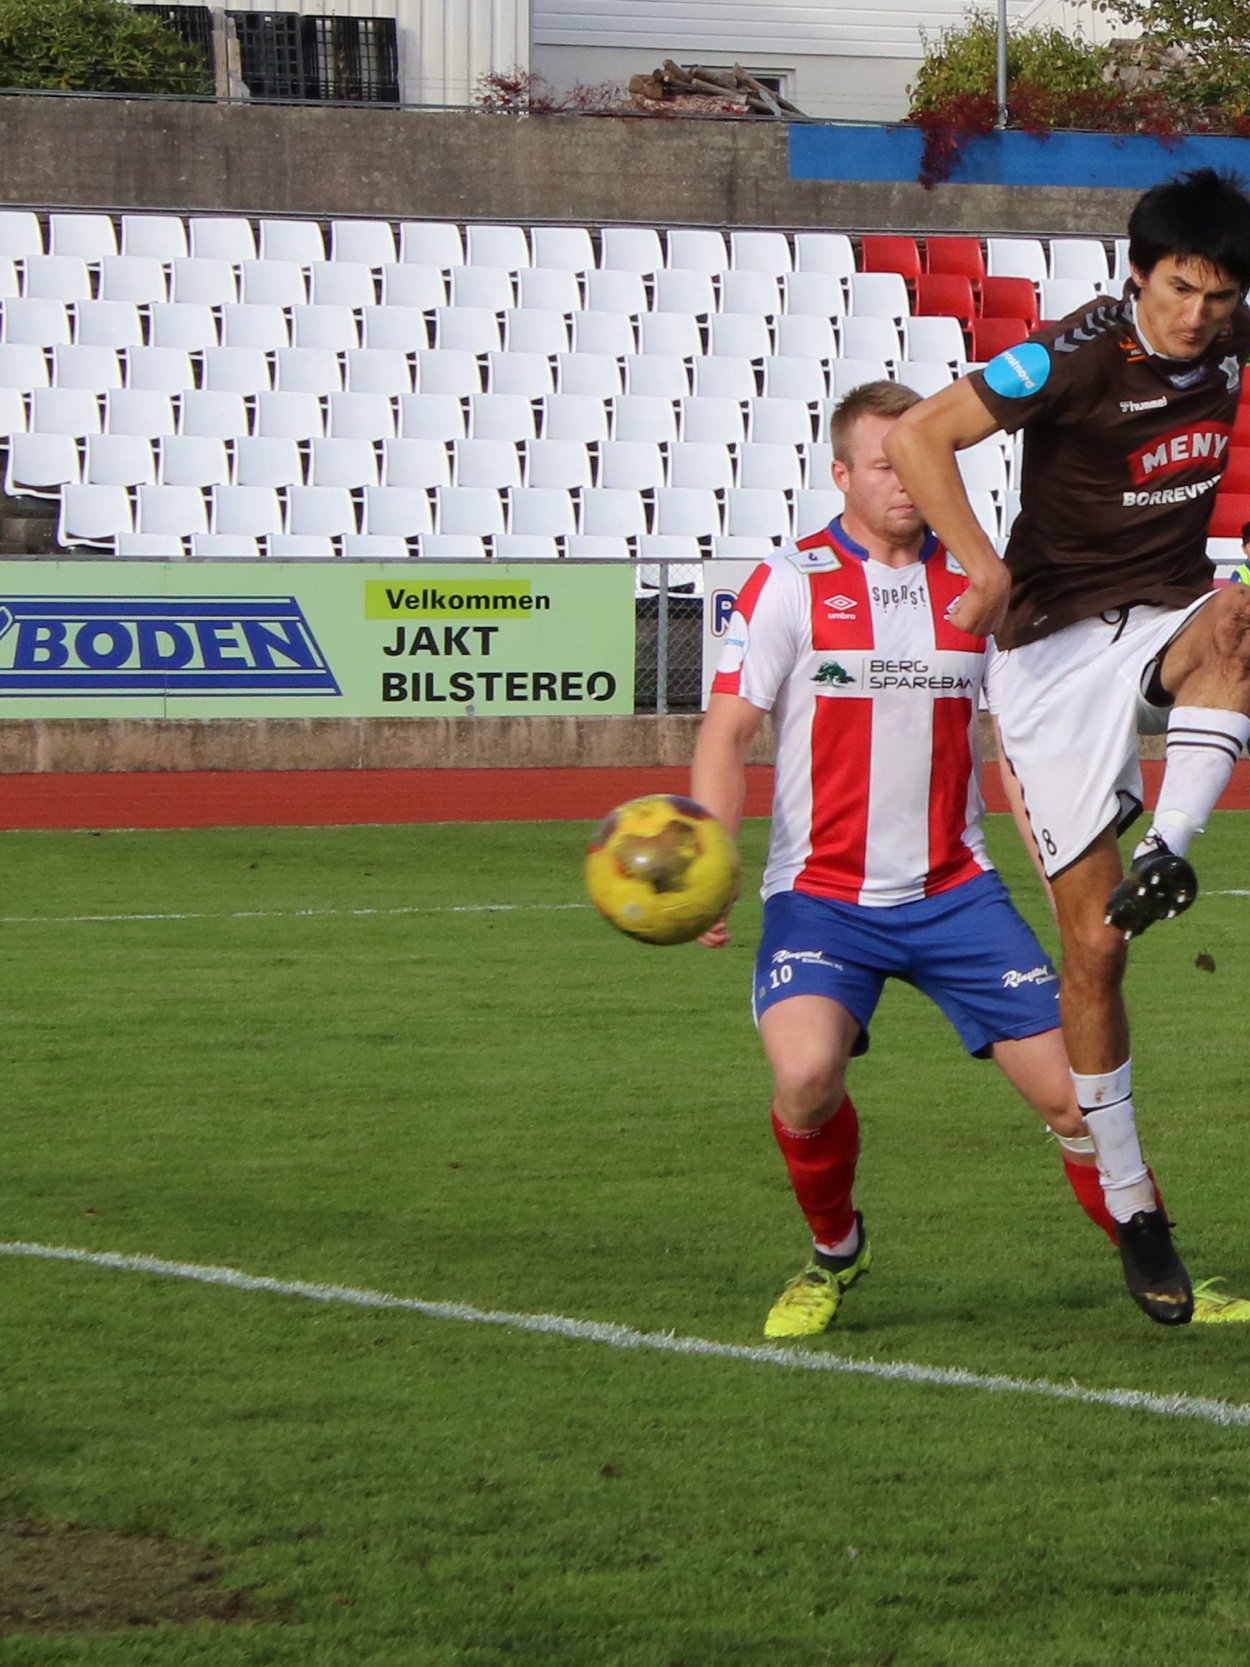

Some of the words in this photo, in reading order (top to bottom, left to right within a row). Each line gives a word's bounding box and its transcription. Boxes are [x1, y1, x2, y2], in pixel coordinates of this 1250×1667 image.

[1142, 431, 1229, 475] MENY
[386, 588, 551, 610] Velkommen
[872, 584, 926, 610] spenst
[13, 621, 318, 669] BODEN
[382, 626, 499, 656] JAKT
[870, 660, 928, 673] BERG
[381, 671, 617, 702] BILSTEREO
[870, 676, 974, 689] SPAREBAN
[1042, 828, 1057, 856] 8
[770, 964, 793, 989] 10
